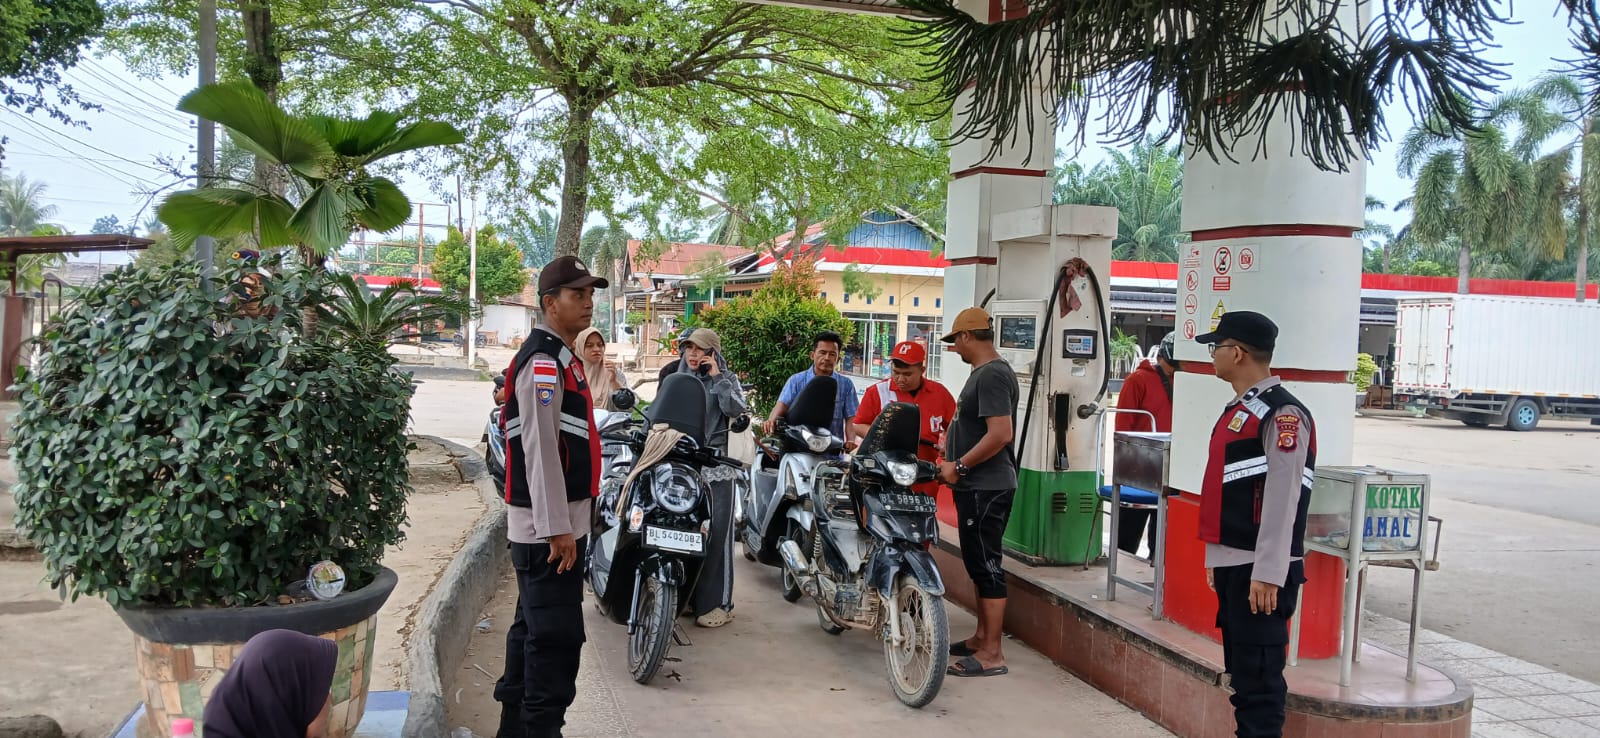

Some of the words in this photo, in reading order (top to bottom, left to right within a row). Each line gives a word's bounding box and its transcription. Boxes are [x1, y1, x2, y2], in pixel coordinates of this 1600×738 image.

[897, 494, 921, 505] 5896
[1367, 486, 1421, 509] KOTAK
[1363, 516, 1411, 538] AMAL
